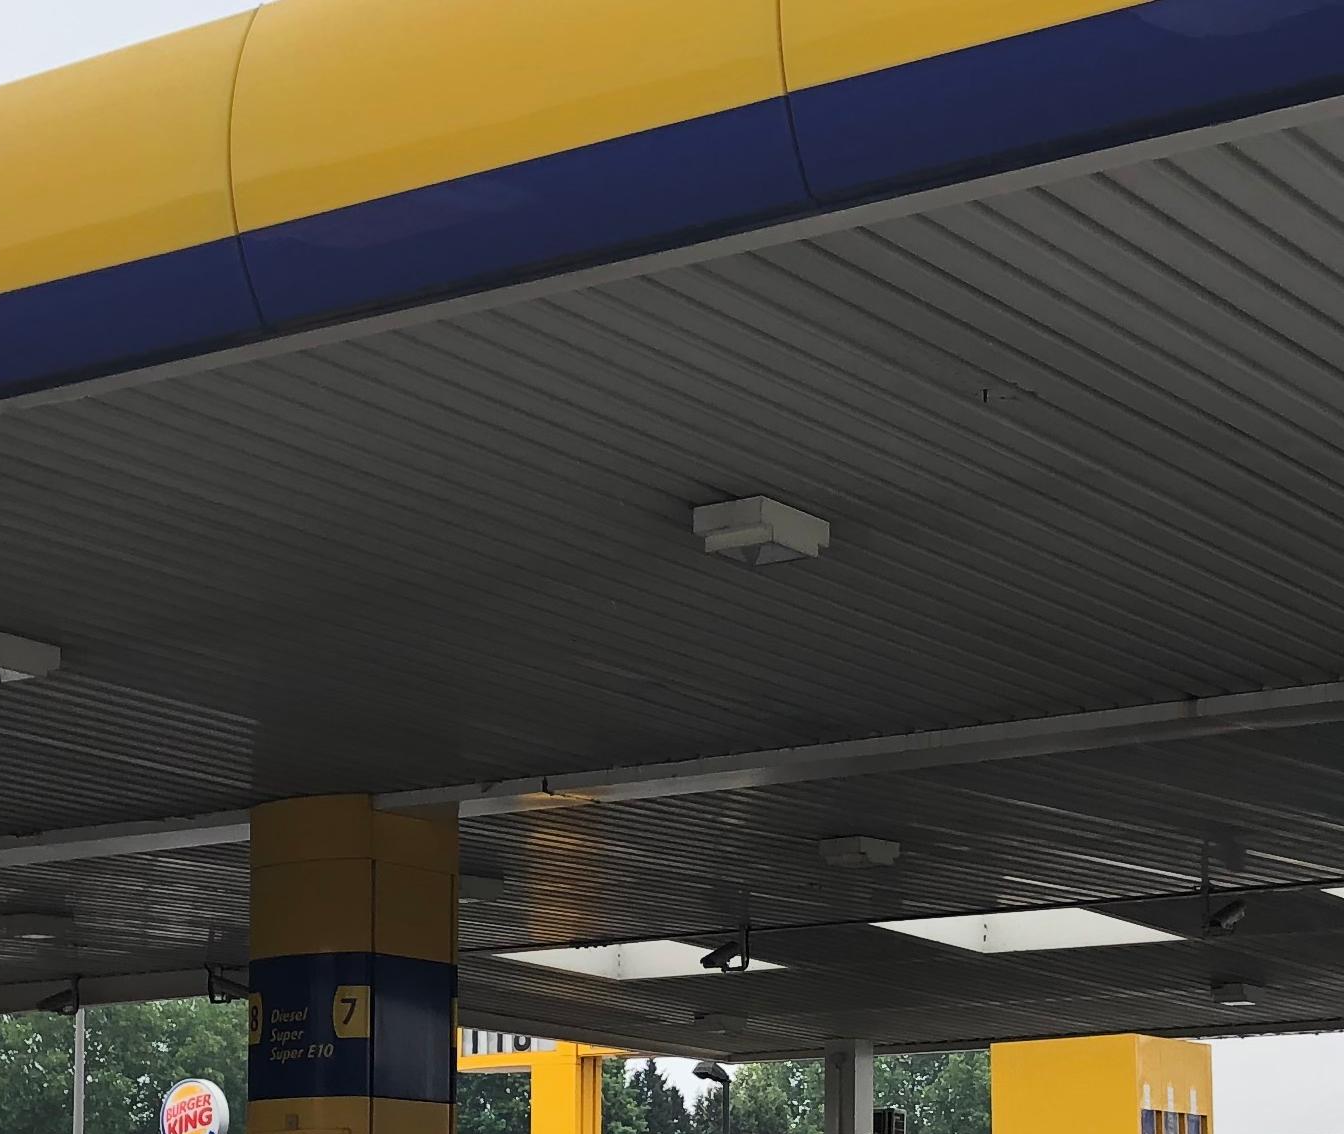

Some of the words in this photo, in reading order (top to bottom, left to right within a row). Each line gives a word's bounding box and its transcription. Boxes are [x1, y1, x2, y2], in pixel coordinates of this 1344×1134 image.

[271, 1007, 308, 1024] Diesel
[341, 998, 357, 1025] 7
[270, 1028, 304, 1047] Super
[270, 1047, 304, 1064] Super
[307, 1043, 334, 1059] E10
[166, 1094, 212, 1121] BURGER
